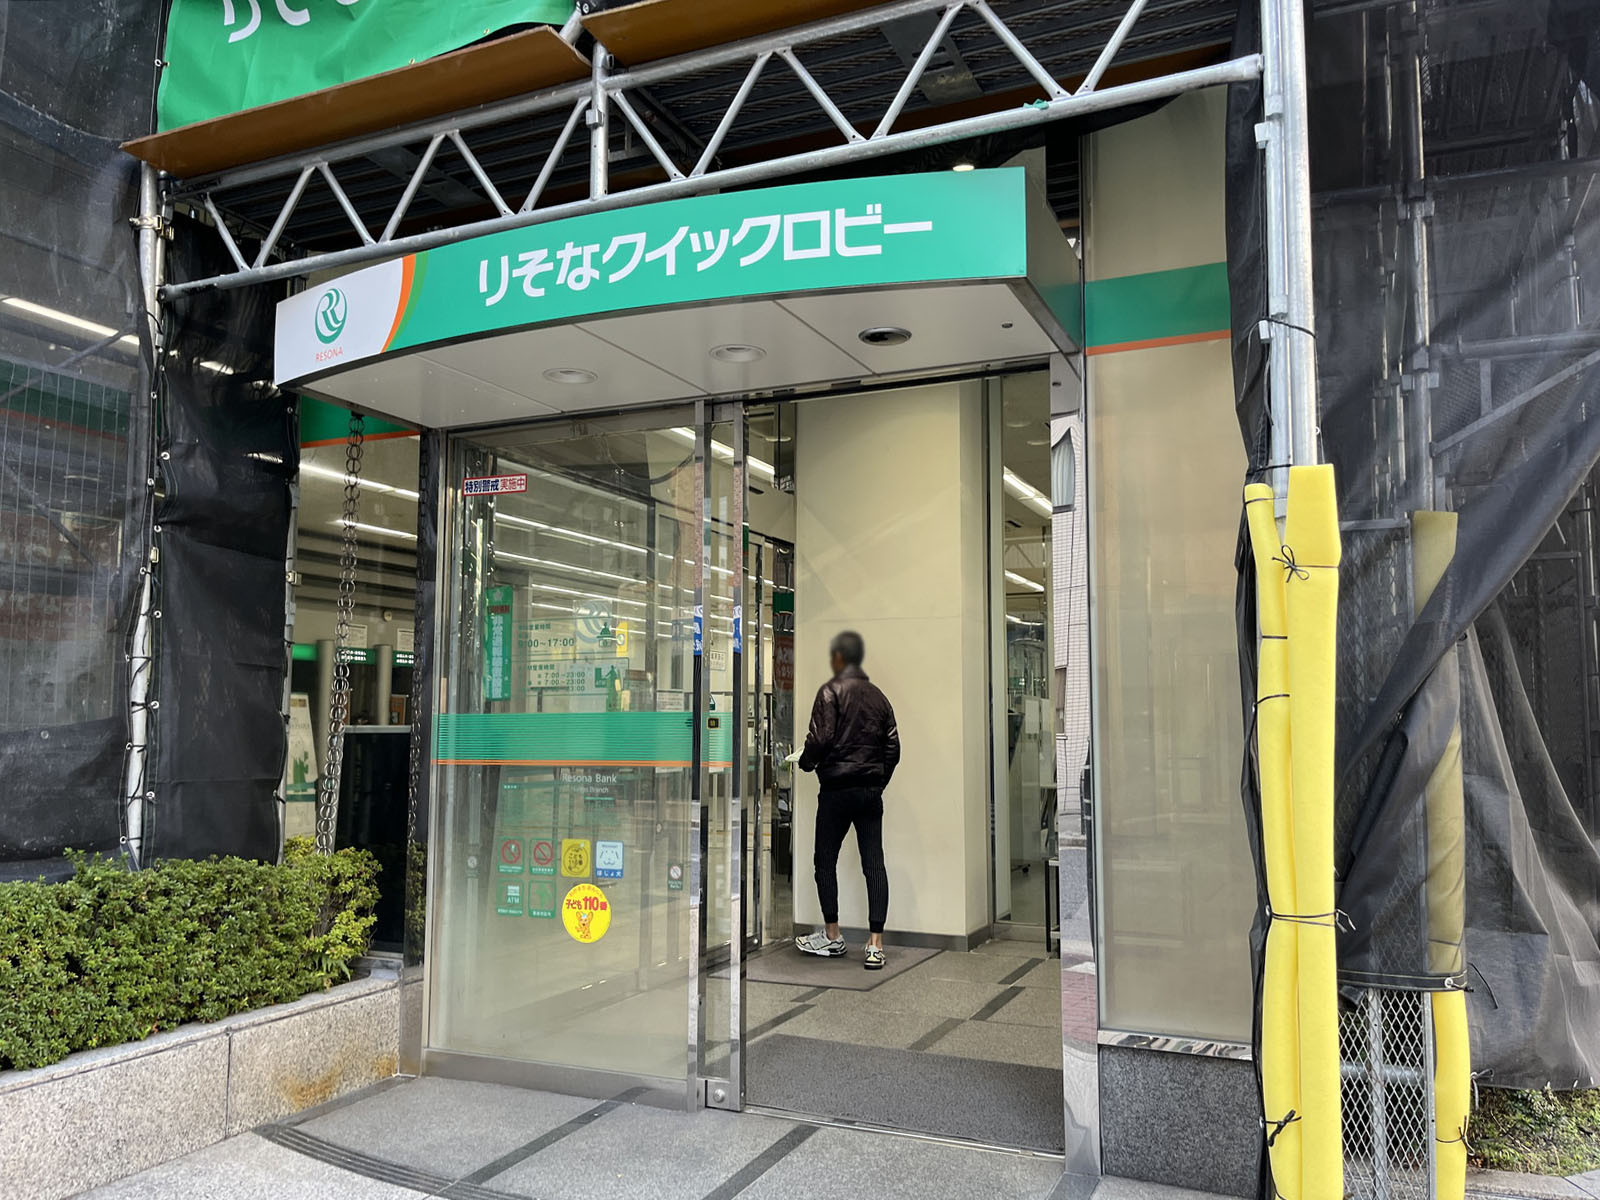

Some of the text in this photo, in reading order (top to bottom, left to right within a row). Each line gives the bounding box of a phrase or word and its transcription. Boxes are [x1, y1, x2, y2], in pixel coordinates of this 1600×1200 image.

[478, 202, 934, 307] りそなクイックロビー
[315, 346, 344, 361] RESONA
[465, 477, 525, 493] 特別警戒実施中
[562, 772, 618, 783] Resona Bank
